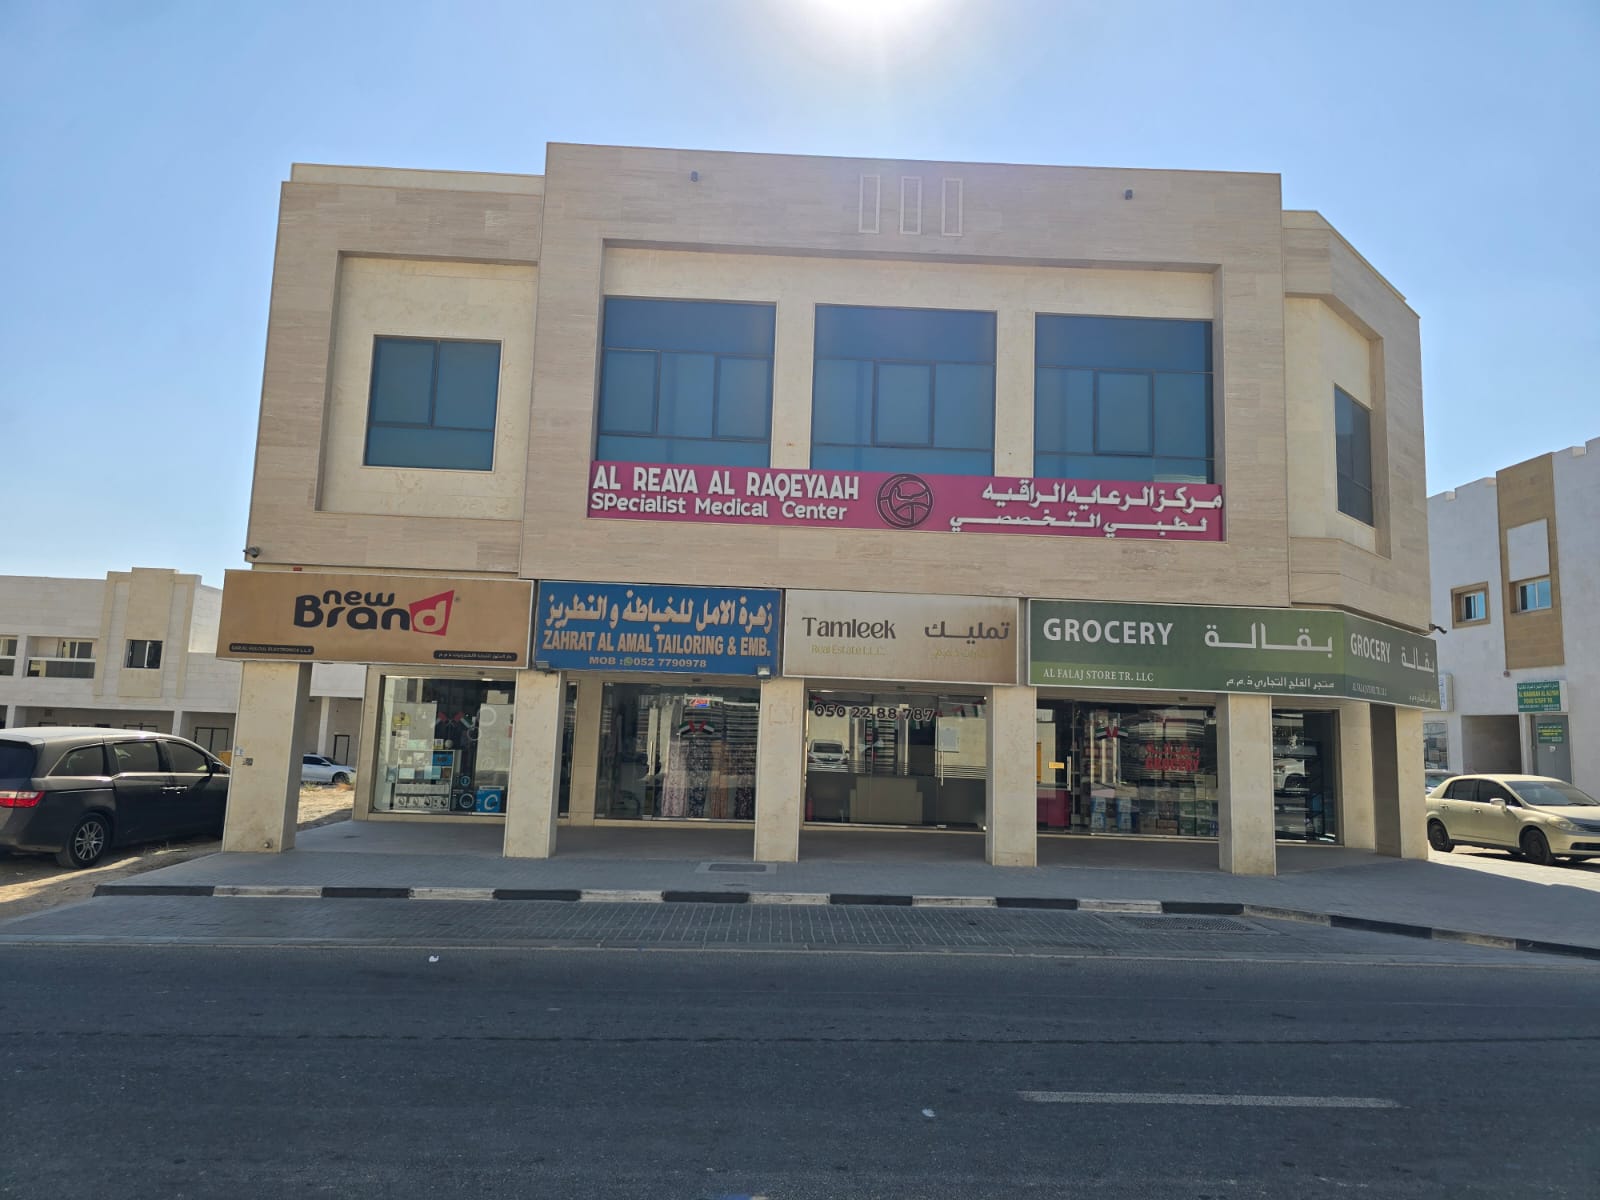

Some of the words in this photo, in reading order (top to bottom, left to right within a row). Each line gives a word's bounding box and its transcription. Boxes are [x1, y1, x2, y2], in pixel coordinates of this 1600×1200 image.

[592, 465, 621, 490] AL
[633, 467, 698, 494] REAYA
[708, 470, 735, 496] AL
[746, 472, 860, 501] RAQEYAAH
[694, 498, 768, 518] Medical
[782, 501, 847, 520] Center
[1152, 486, 1222, 513] مركز
[949, 509, 1100, 533] التخصصي
[323, 589, 395, 607] new
[293, 594, 449, 634] Brand
[609, 603, 619, 629] و
[738, 596, 773, 634] زهرة
[801, 616, 896, 639] Tamleek
[924, 620, 1010, 645] تمليك
[1042, 617, 1174, 646] GROCERY
[1203, 622, 1334, 659] بقالة
[542, 630, 596, 651] ZAHRAT
[597, 632, 614, 652] AL
[617, 633, 653, 653] AMAL
[656, 634, 724, 656] TAILORING
[727, 635, 737, 656] &
[740, 636, 771, 657] EMB.
[1350, 632, 1391, 664] GROCERY
[588, 656, 616, 666] MOB
[633, 657, 655, 667] 052
[658, 658, 707, 668] 7790978
[1043, 667, 1056, 678] AL
[1057, 668, 1084, 681] FALAJ
[1086, 670, 1117, 680] STORE
[1118, 671, 1134, 681] TR.
[1136, 672, 1154, 682] LLC
[1400, 645, 1435, 679] بقالة
[814, 704, 847, 718] 050
[852, 706, 871, 719] 22
[876, 707, 898, 720] 88
[903, 708, 935, 721] 787
